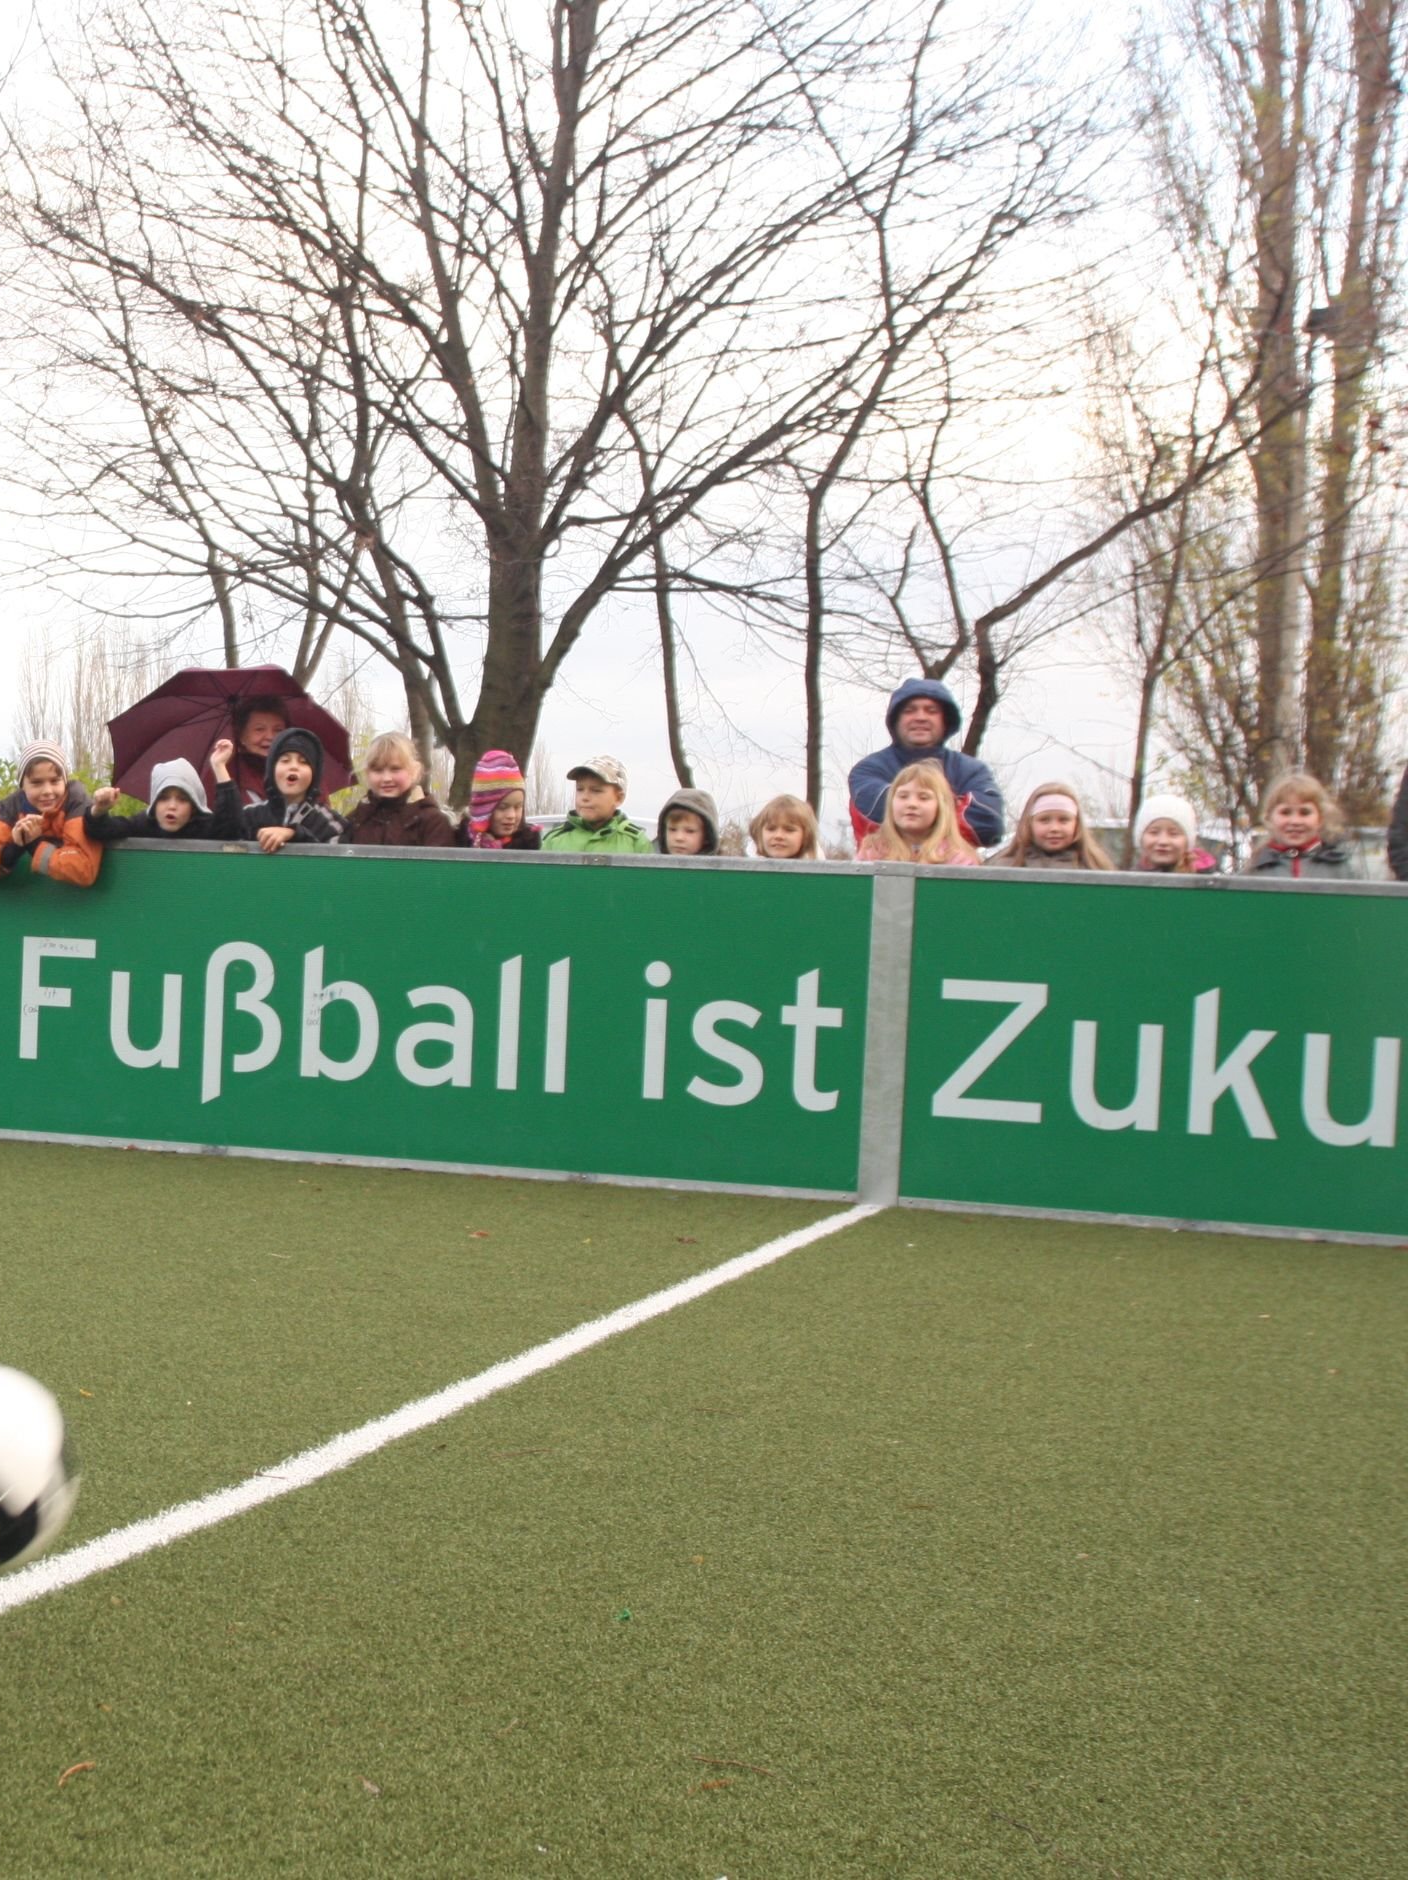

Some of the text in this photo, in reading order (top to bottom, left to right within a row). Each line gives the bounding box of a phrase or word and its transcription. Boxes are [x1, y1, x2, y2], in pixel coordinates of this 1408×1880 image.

[19, 935, 1401, 1148] Fußball ist Zuku
